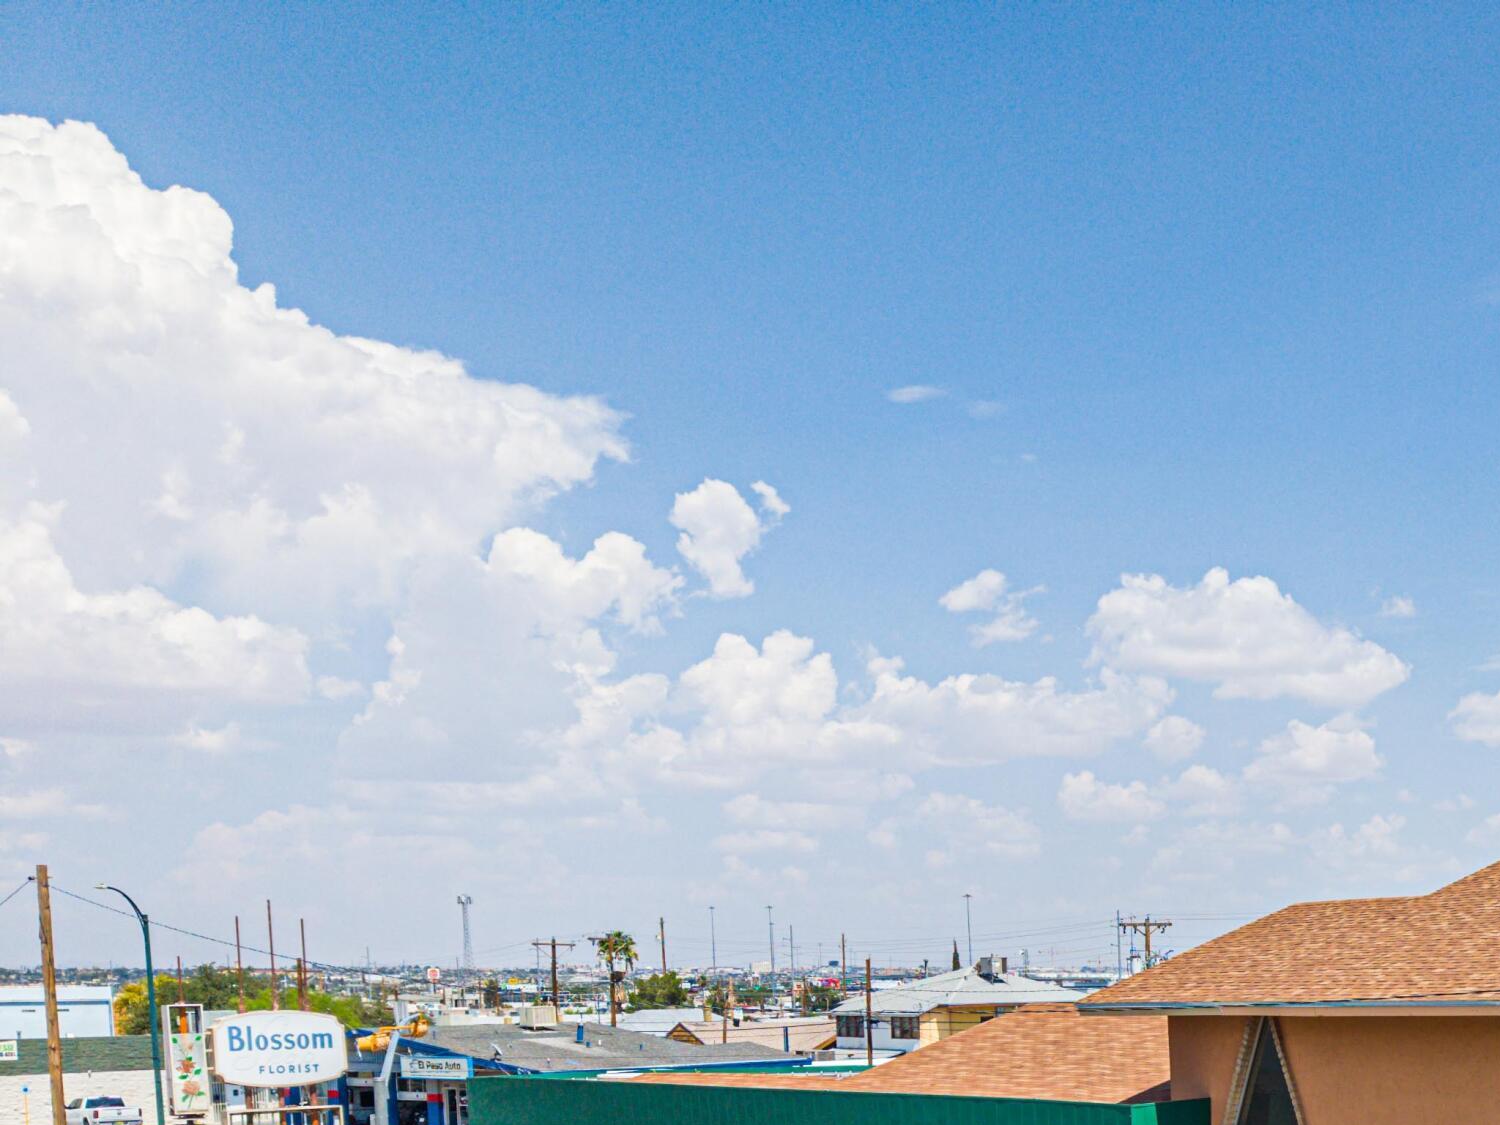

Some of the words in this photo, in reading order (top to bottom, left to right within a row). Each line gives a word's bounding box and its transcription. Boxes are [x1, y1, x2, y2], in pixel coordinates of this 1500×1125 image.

[227, 1025, 333, 1052] Blossom
[258, 1063, 320, 1075] FLORIST
[445, 1061, 461, 1070] Auto
